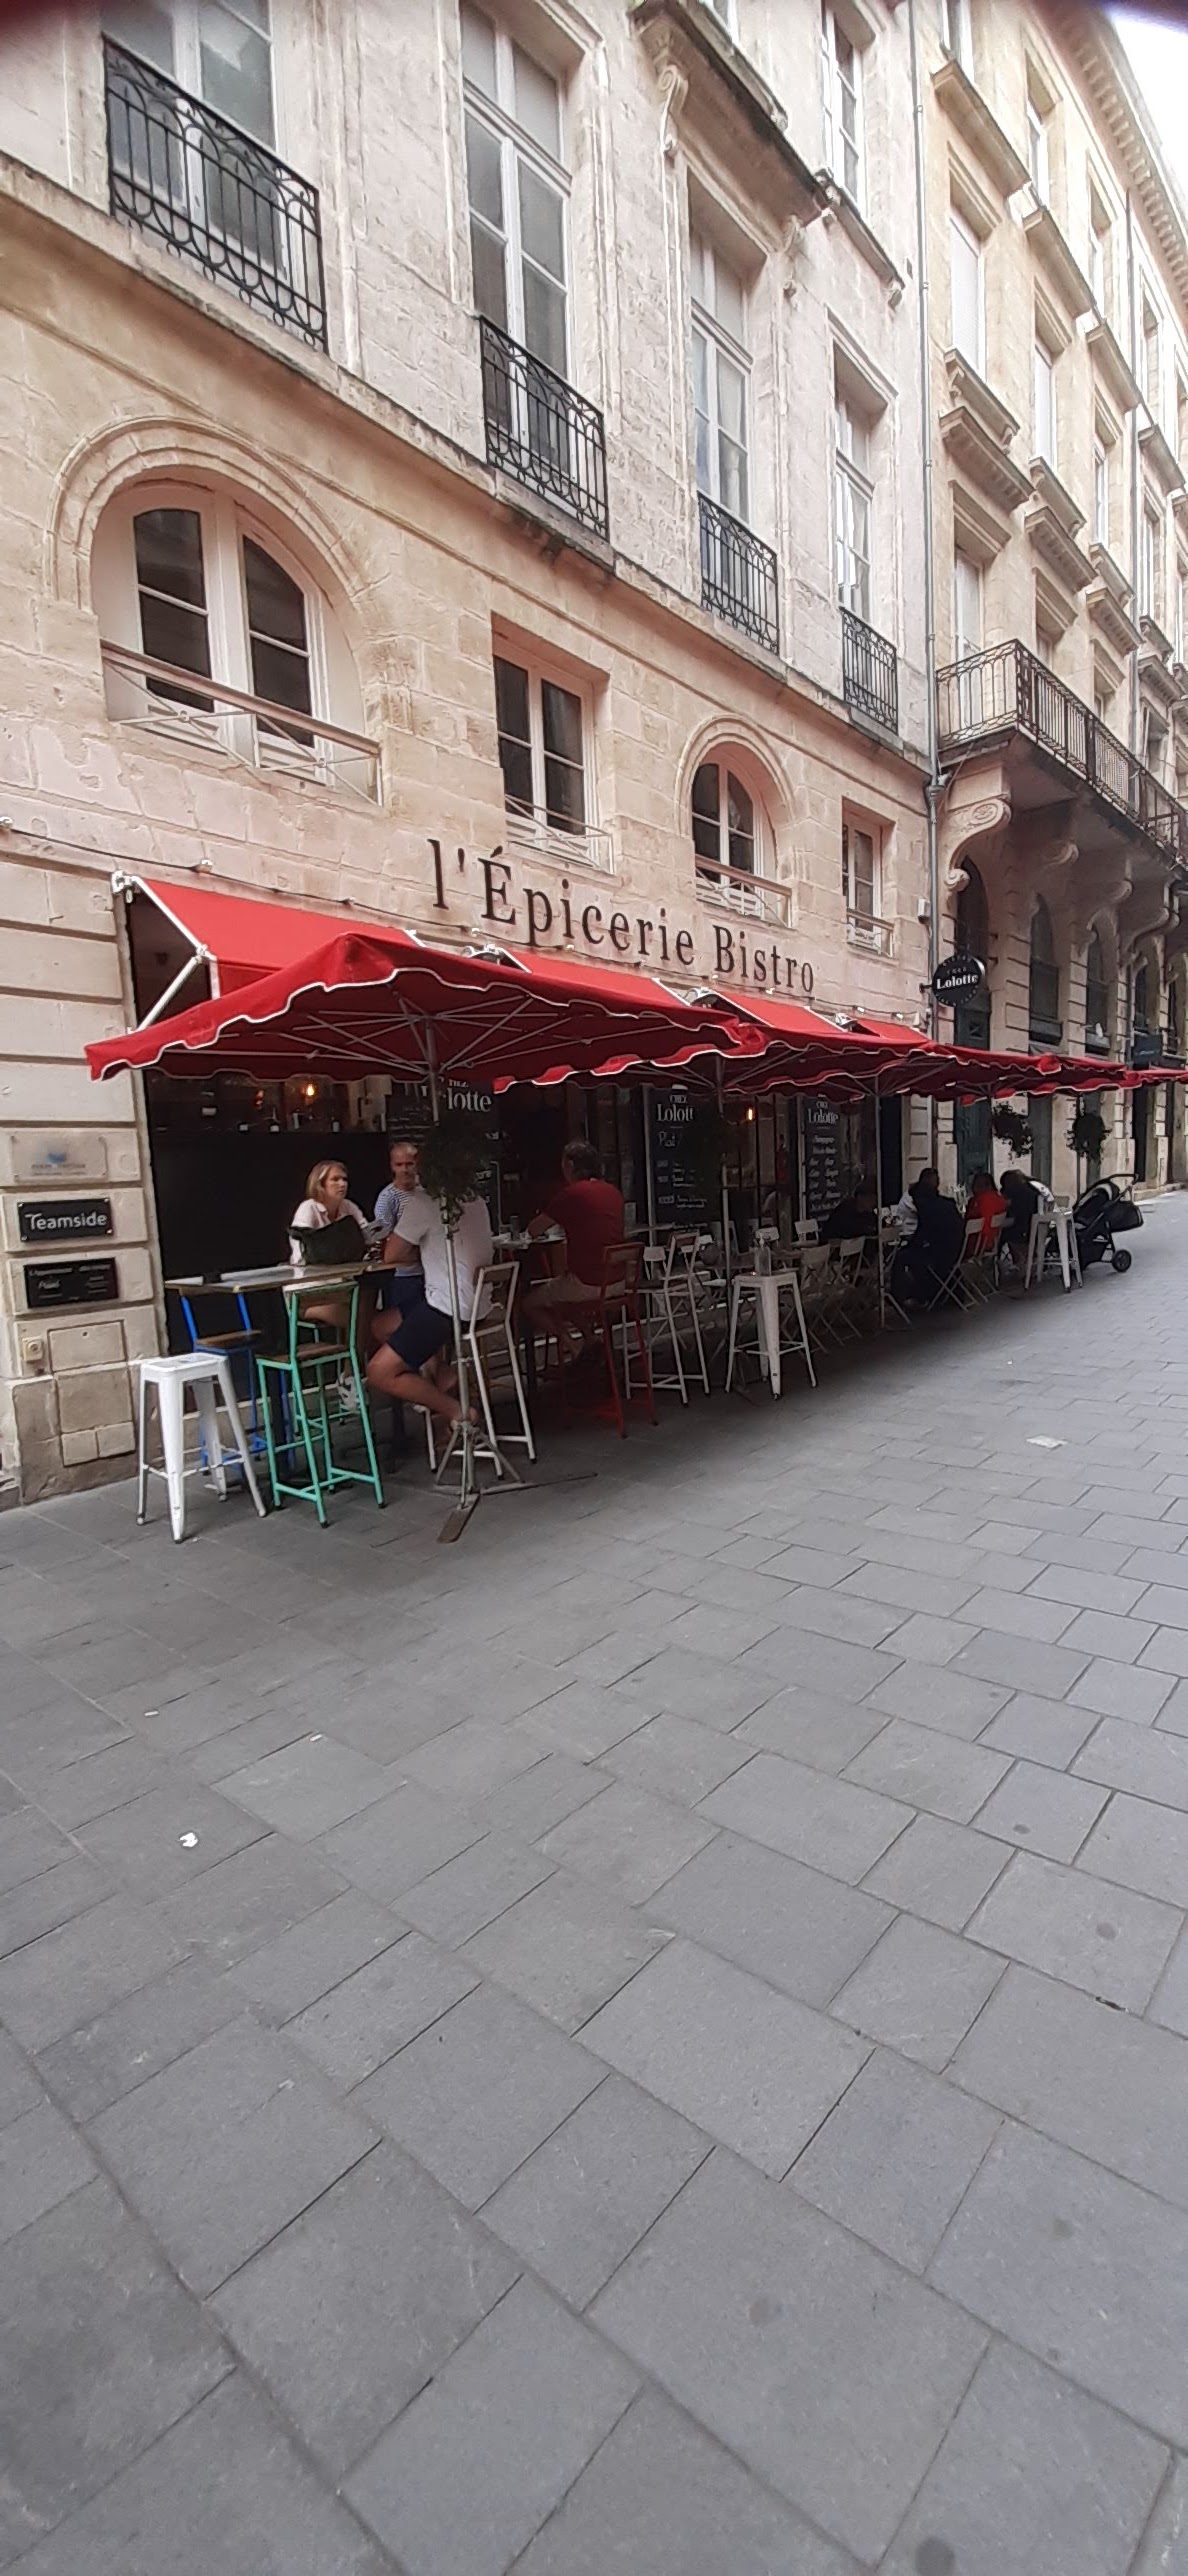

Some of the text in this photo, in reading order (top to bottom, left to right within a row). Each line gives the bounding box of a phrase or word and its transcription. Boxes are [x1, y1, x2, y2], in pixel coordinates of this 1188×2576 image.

[427, 838, 814, 993] l'Épicerie Bistro
[937, 974, 979, 989] Lolotte
[657, 1103, 694, 1121] Lolott
[25, 1212, 107, 1230] Teamside
